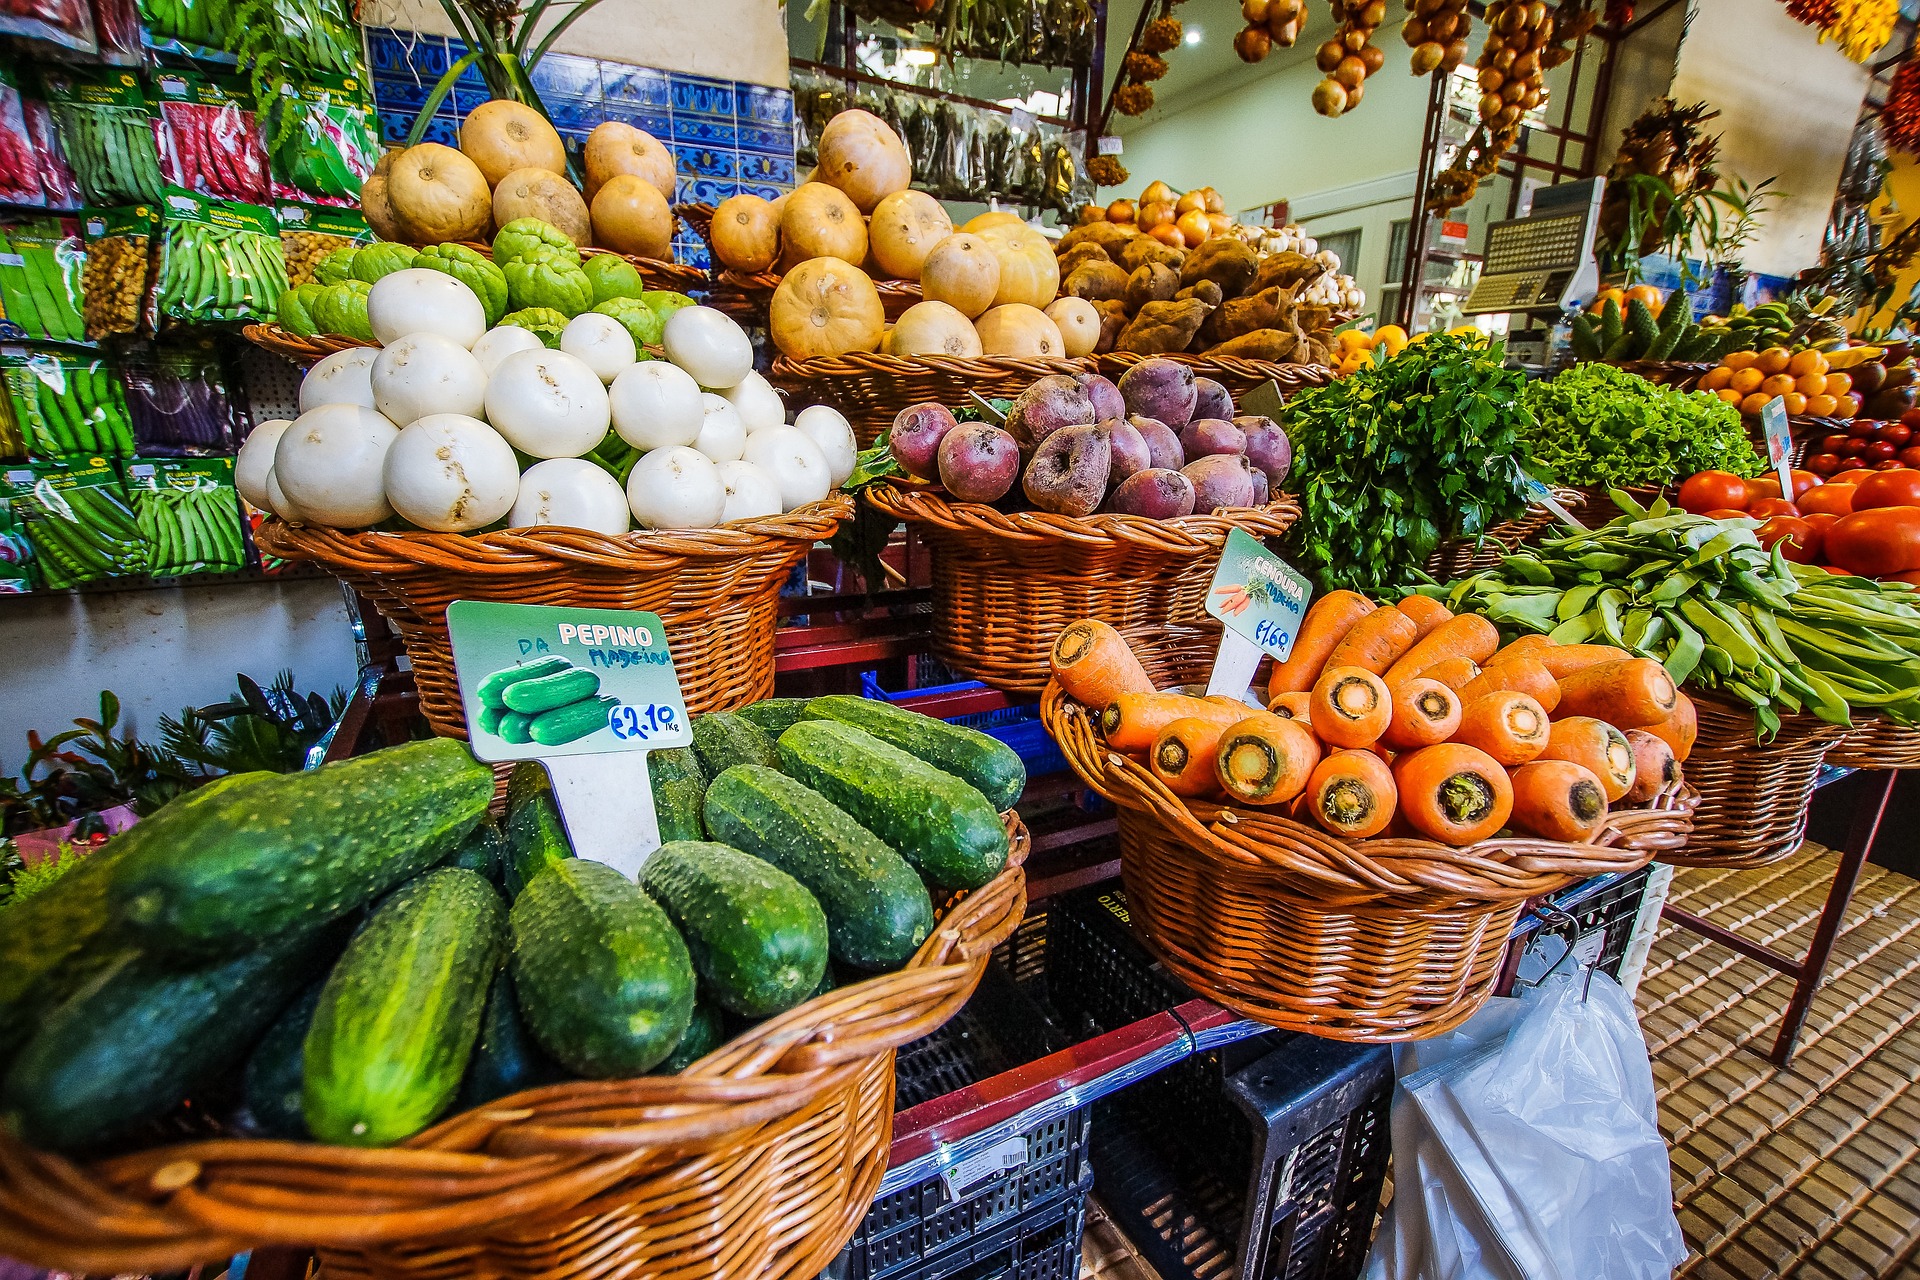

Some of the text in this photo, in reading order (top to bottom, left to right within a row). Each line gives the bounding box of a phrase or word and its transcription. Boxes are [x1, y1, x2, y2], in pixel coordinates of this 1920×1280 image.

[1254, 556, 1304, 602] CENOURA
[518, 638, 550, 656] DA
[557, 623, 653, 647] PEPINO
